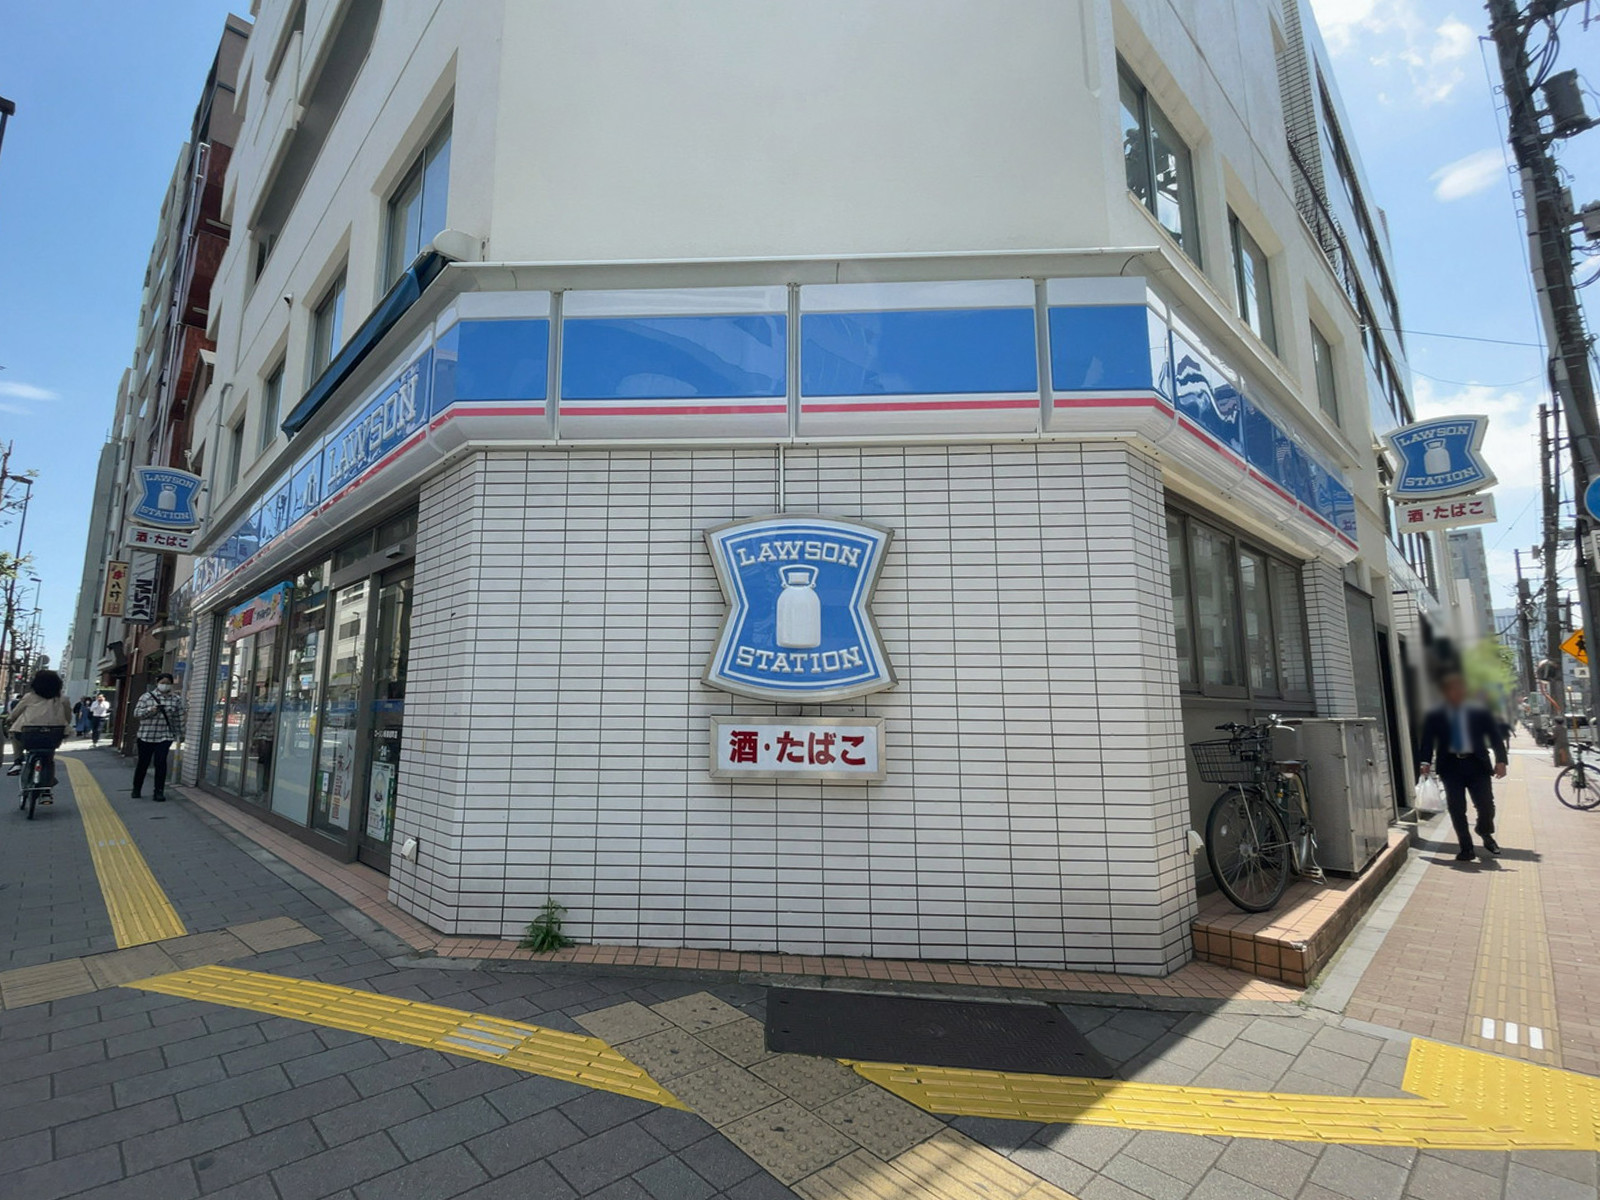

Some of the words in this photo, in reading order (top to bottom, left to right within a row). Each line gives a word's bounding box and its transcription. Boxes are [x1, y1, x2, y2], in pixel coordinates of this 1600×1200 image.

[327, 373, 419, 486] LAWSON
[1400, 426, 1469, 446] LAWSON
[145, 474, 194, 489] LAWSON
[1405, 467, 1476, 486] STATION
[140, 506, 189, 519] STATION
[1407, 501, 1484, 523] 酒・たばこ
[135, 531, 188, 548] 酒・たばこ
[737, 541, 862, 568] LAWSON
[736, 646, 863, 673] STATION
[729, 730, 867, 766] 酒・たばこ
